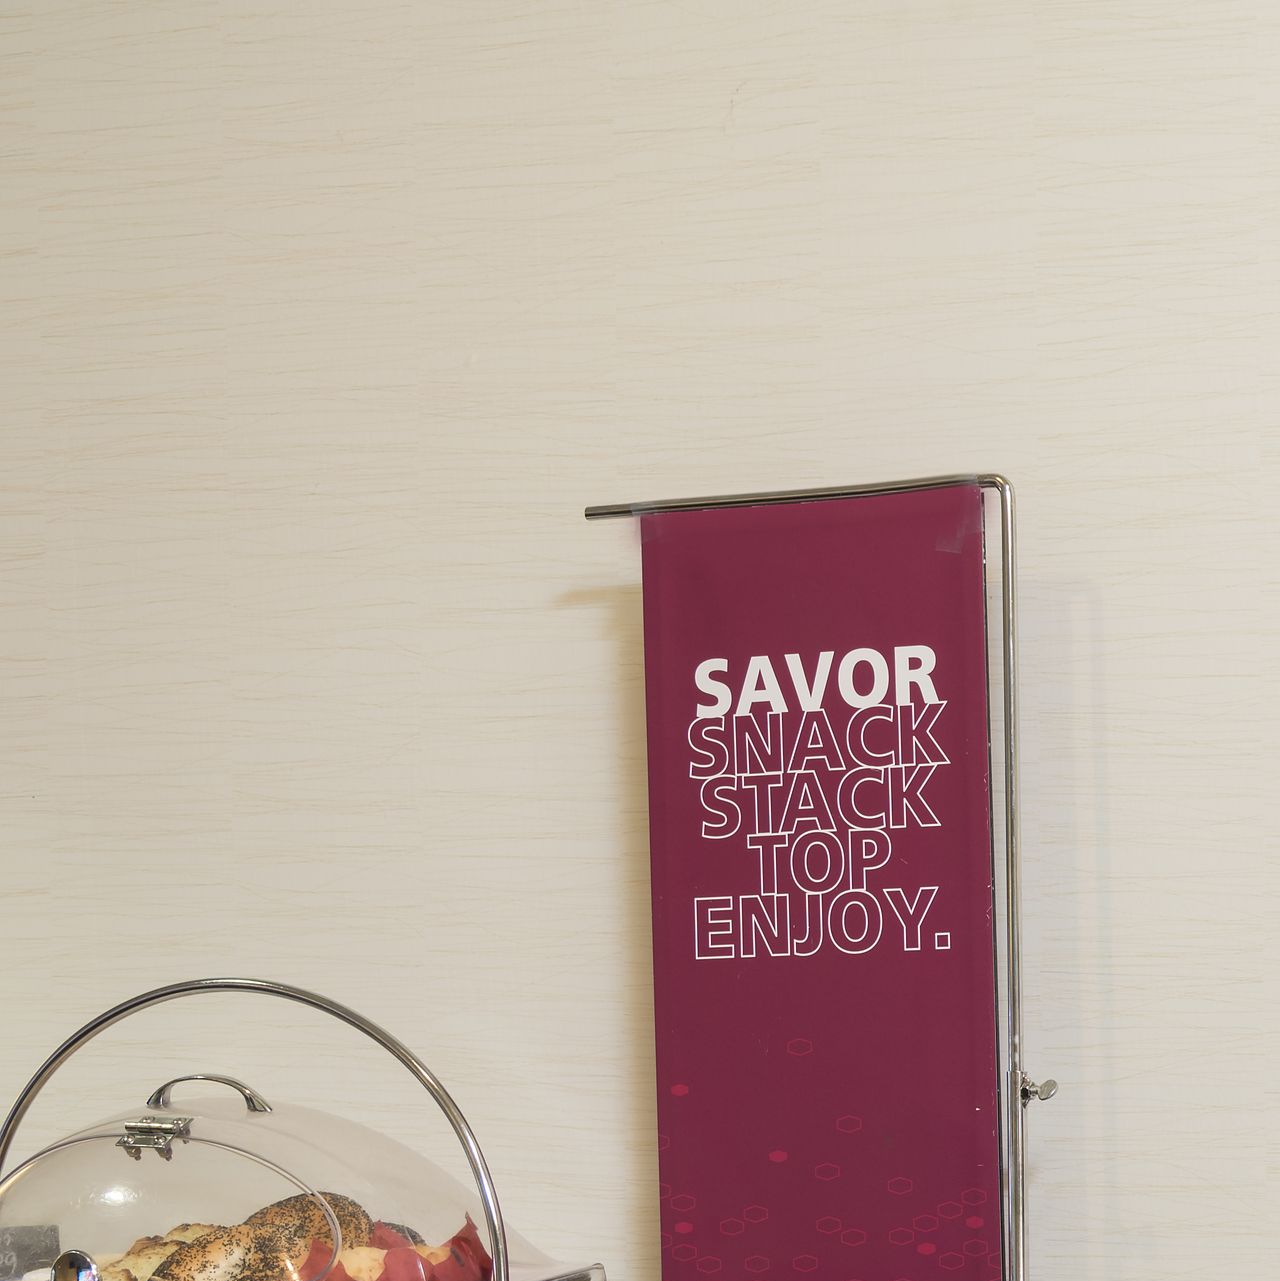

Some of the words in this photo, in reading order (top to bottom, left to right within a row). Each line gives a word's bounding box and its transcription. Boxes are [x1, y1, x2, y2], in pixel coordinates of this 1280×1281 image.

[694, 644, 939, 718] SAVOR
[688, 700, 951, 779] SNACK
[700, 764, 941, 839] STACK
[747, 829, 892, 896] TOP
[694, 886, 951, 960] ENJOY.
